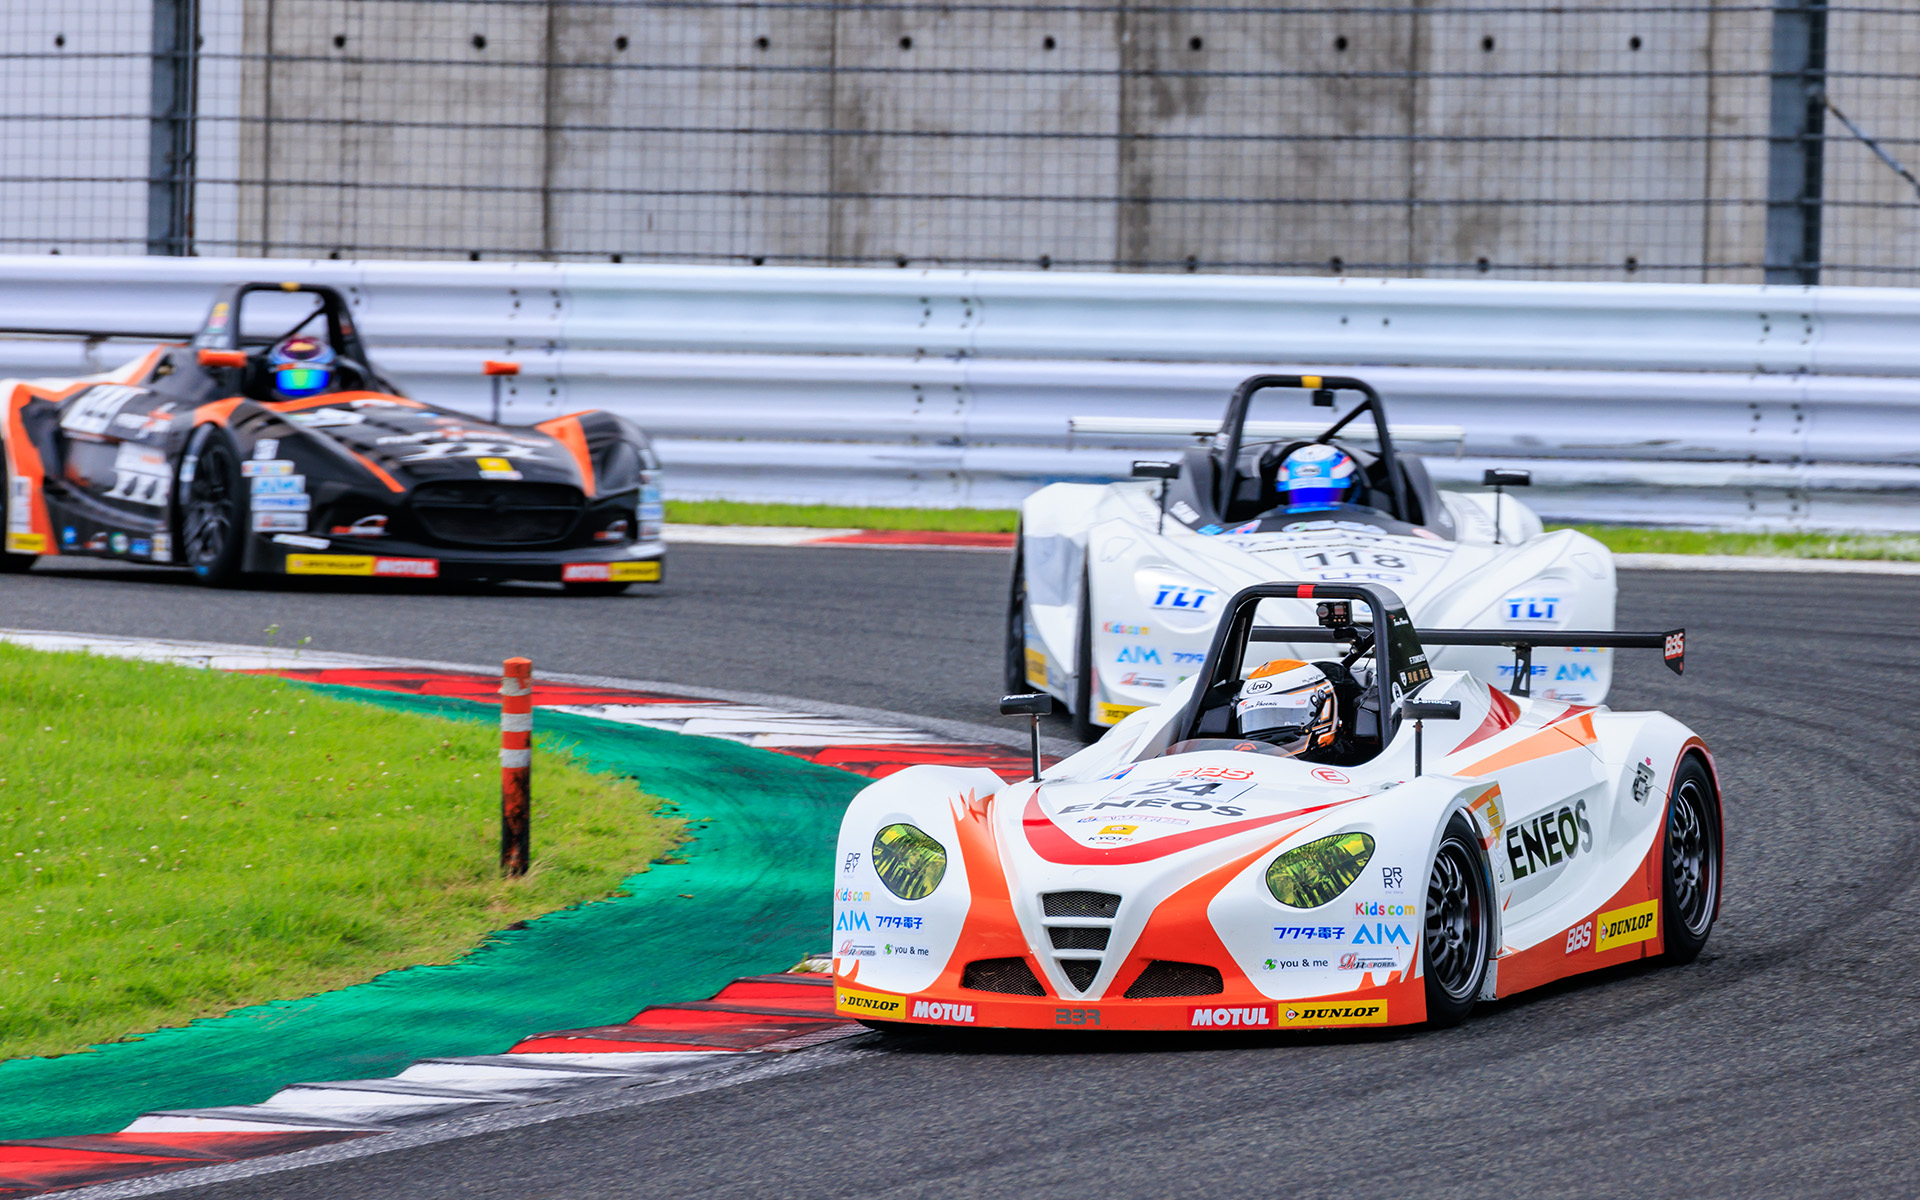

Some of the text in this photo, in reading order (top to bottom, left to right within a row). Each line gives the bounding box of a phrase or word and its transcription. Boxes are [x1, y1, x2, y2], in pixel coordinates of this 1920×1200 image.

[1305, 551, 1406, 568] 118
[1154, 585, 1217, 609] TLT
[1505, 597, 1560, 619] TLT
[1665, 632, 1684, 660] BBS
[1168, 766, 1254, 780] BBS
[1130, 780, 1223, 797] 24
[1057, 798, 1247, 817] ENEOS
[1506, 799, 1593, 881] ENEOS
[1382, 867, 1403, 878] DR
[1383, 878, 1403, 889] RY
[836, 910, 871, 931] AIM
[1608, 912, 1653, 938] DUNLOP
[1351, 923, 1411, 945] AIM
[1565, 921, 1593, 955] BBS
[894, 946, 929, 956] you & me
[1280, 960, 1299, 969] you
[1302, 959, 1310, 967] &
[847, 996, 900, 1011] DUNLOP
[912, 1000, 975, 1023] MOTUL
[1301, 1007, 1380, 1019] DUNLOP
[1191, 1007, 1270, 1026] MOTUL
